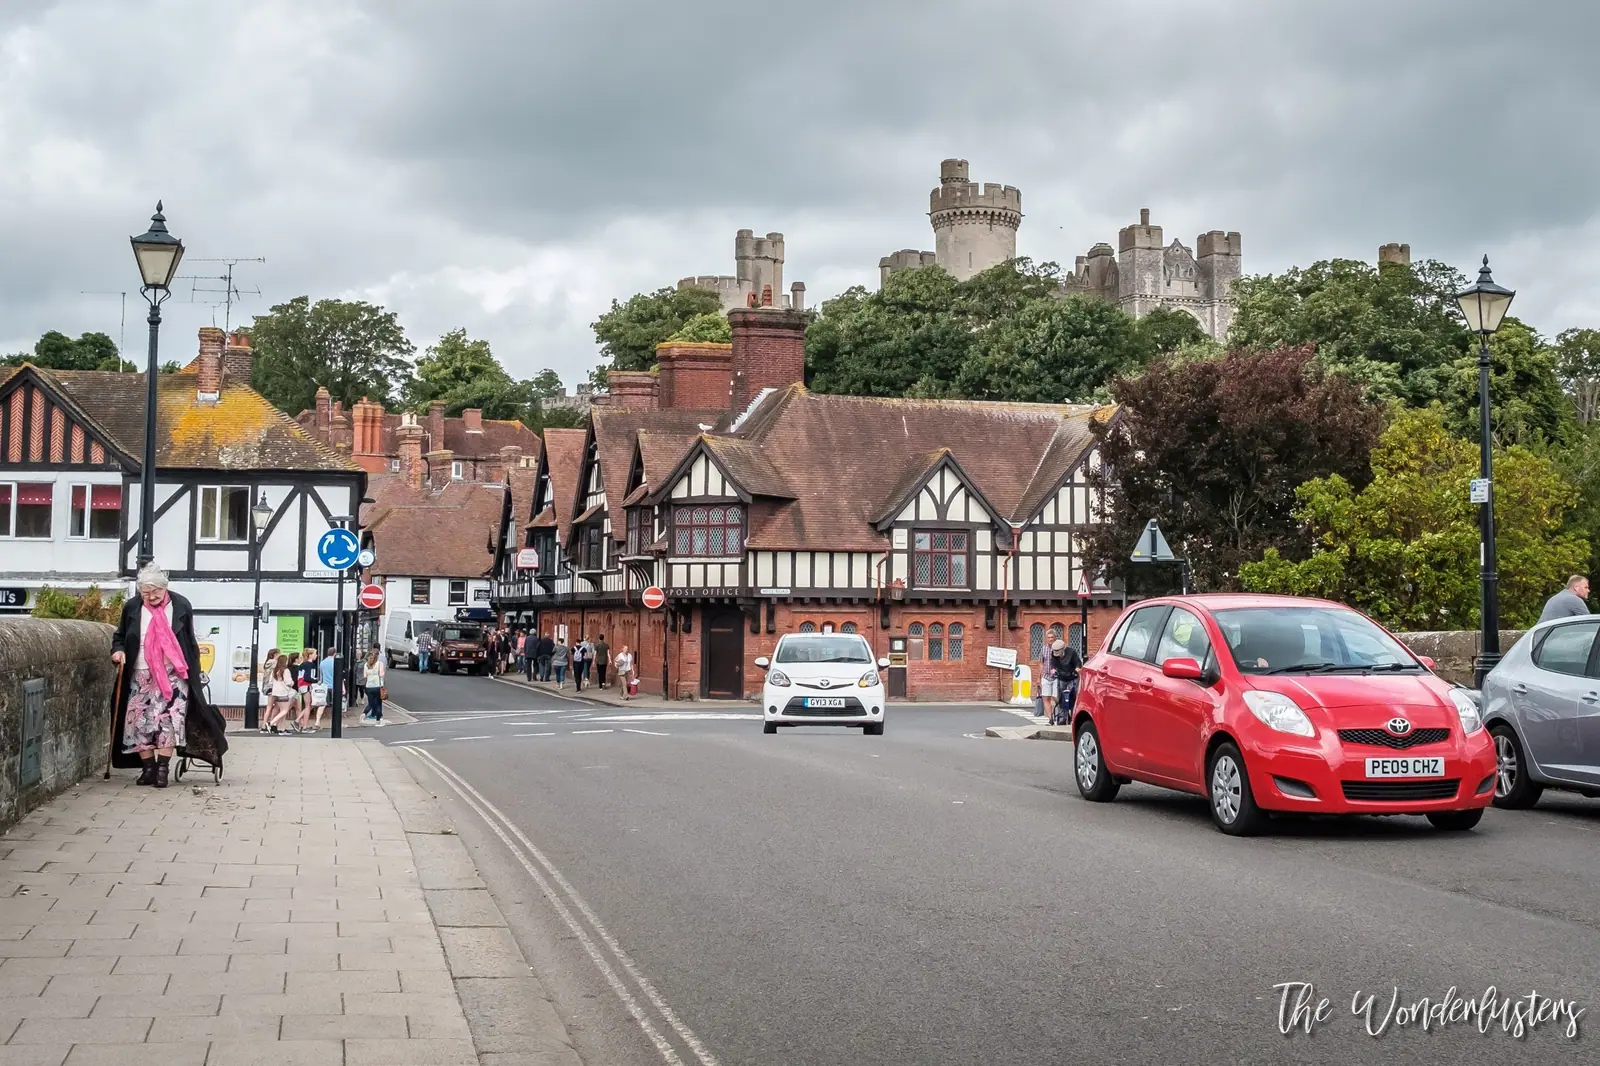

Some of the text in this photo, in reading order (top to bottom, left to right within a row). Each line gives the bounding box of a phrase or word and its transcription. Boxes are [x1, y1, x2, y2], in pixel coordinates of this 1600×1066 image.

[669, 588, 740, 596] POST OFFICE
[810, 698, 843, 707] GY13 XGA
[1371, 758, 1439, 775] PE09 CHZ
